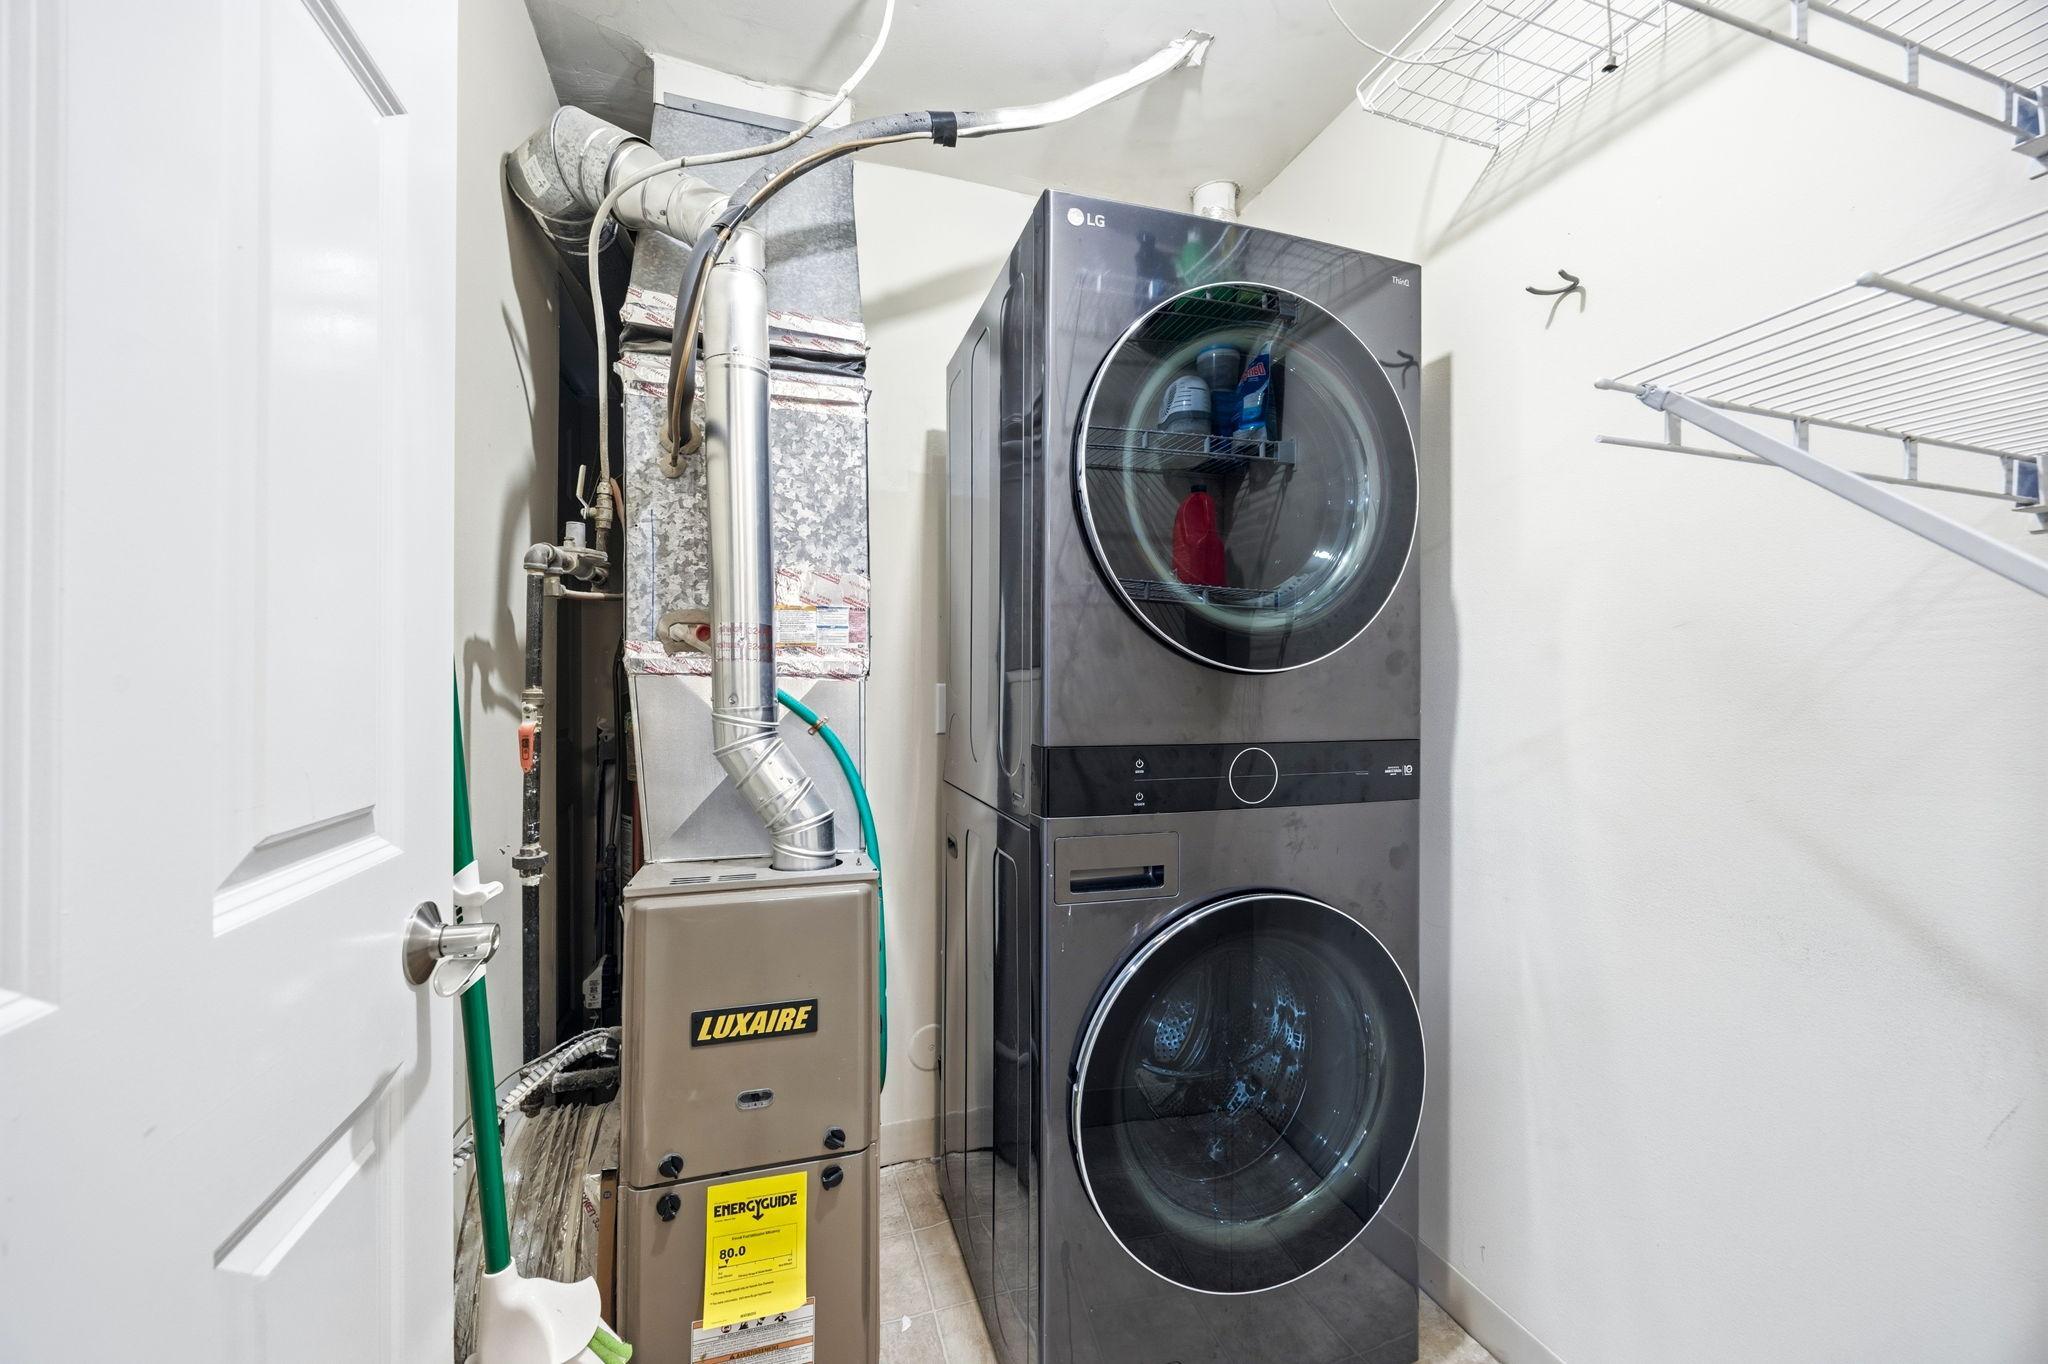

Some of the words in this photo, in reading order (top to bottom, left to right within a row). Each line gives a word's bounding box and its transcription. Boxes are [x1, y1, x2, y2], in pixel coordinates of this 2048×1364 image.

[1086, 212, 1106, 228] LG
[1391, 275, 1410, 287] ThinQ
[697, 1005, 813, 1041] LUXAIRE
[713, 1193, 798, 1219] ENERGYGUIDE
[719, 1245, 746, 1260] 80.0
